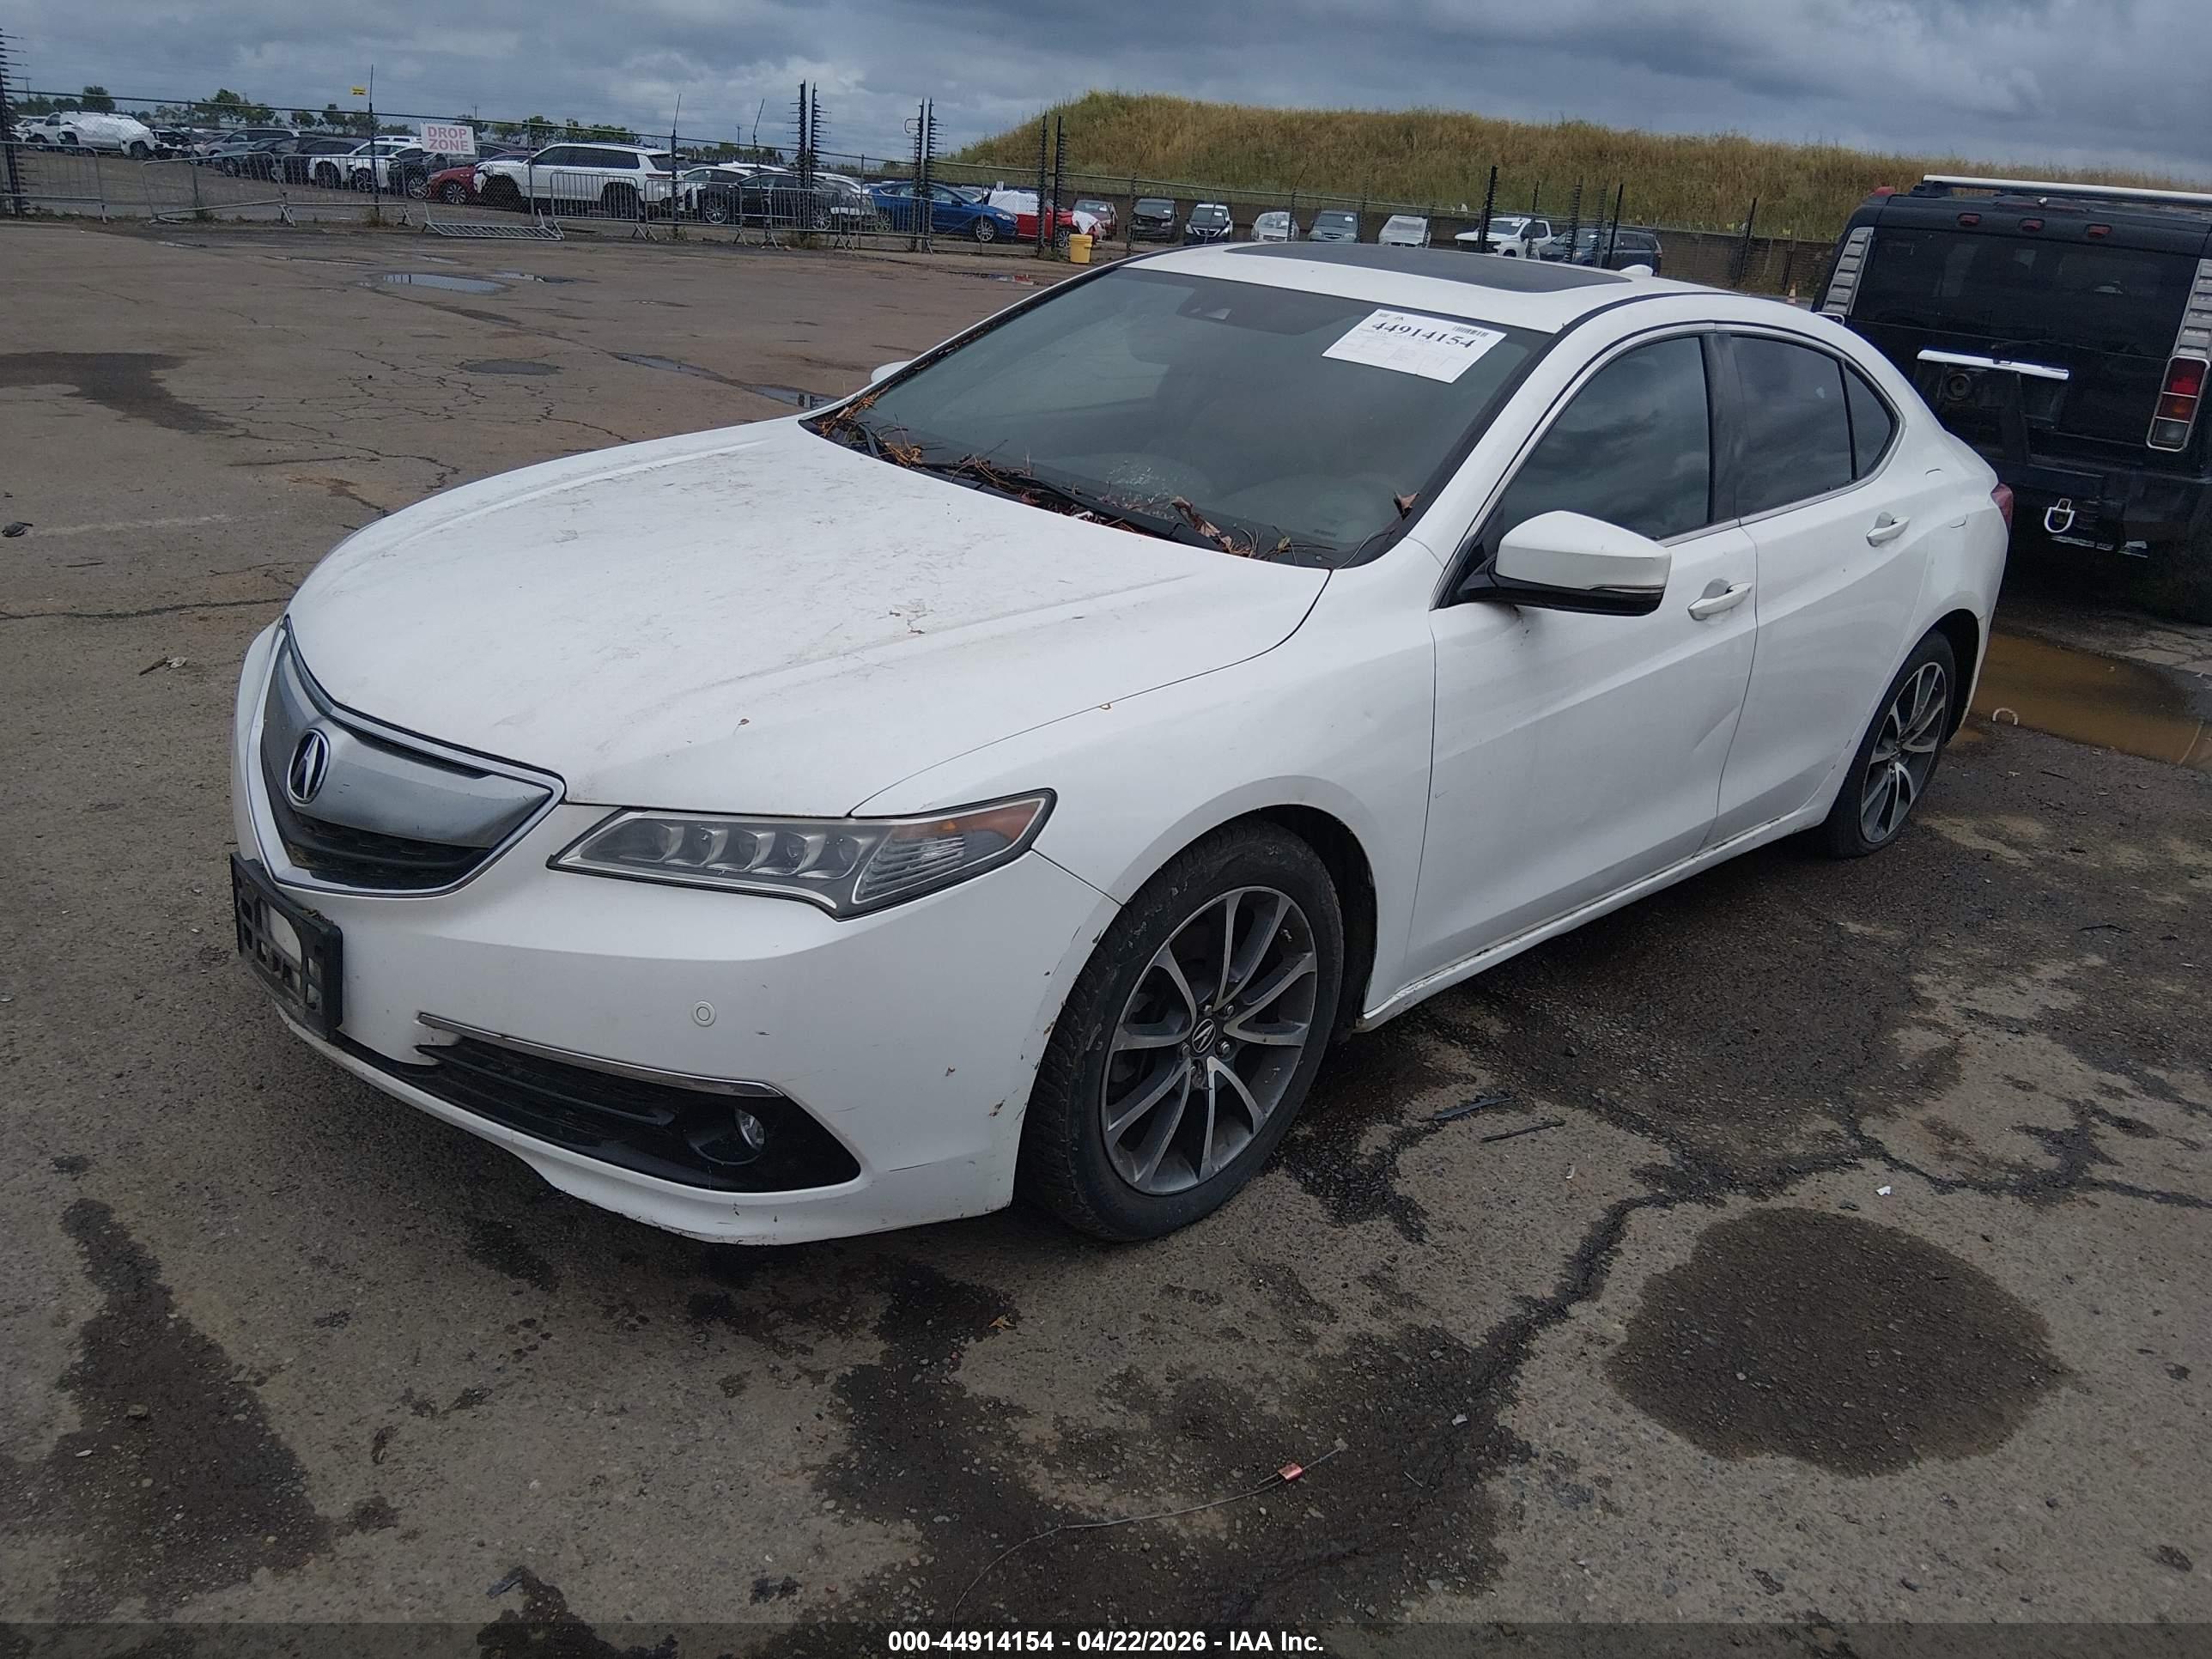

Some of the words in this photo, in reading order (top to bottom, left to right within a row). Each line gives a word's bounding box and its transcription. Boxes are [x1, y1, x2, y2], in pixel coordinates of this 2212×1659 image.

[427, 126, 467, 139] DROP
[428, 139, 469, 151] ZONE
[1372, 322, 1477, 349] 44914154
